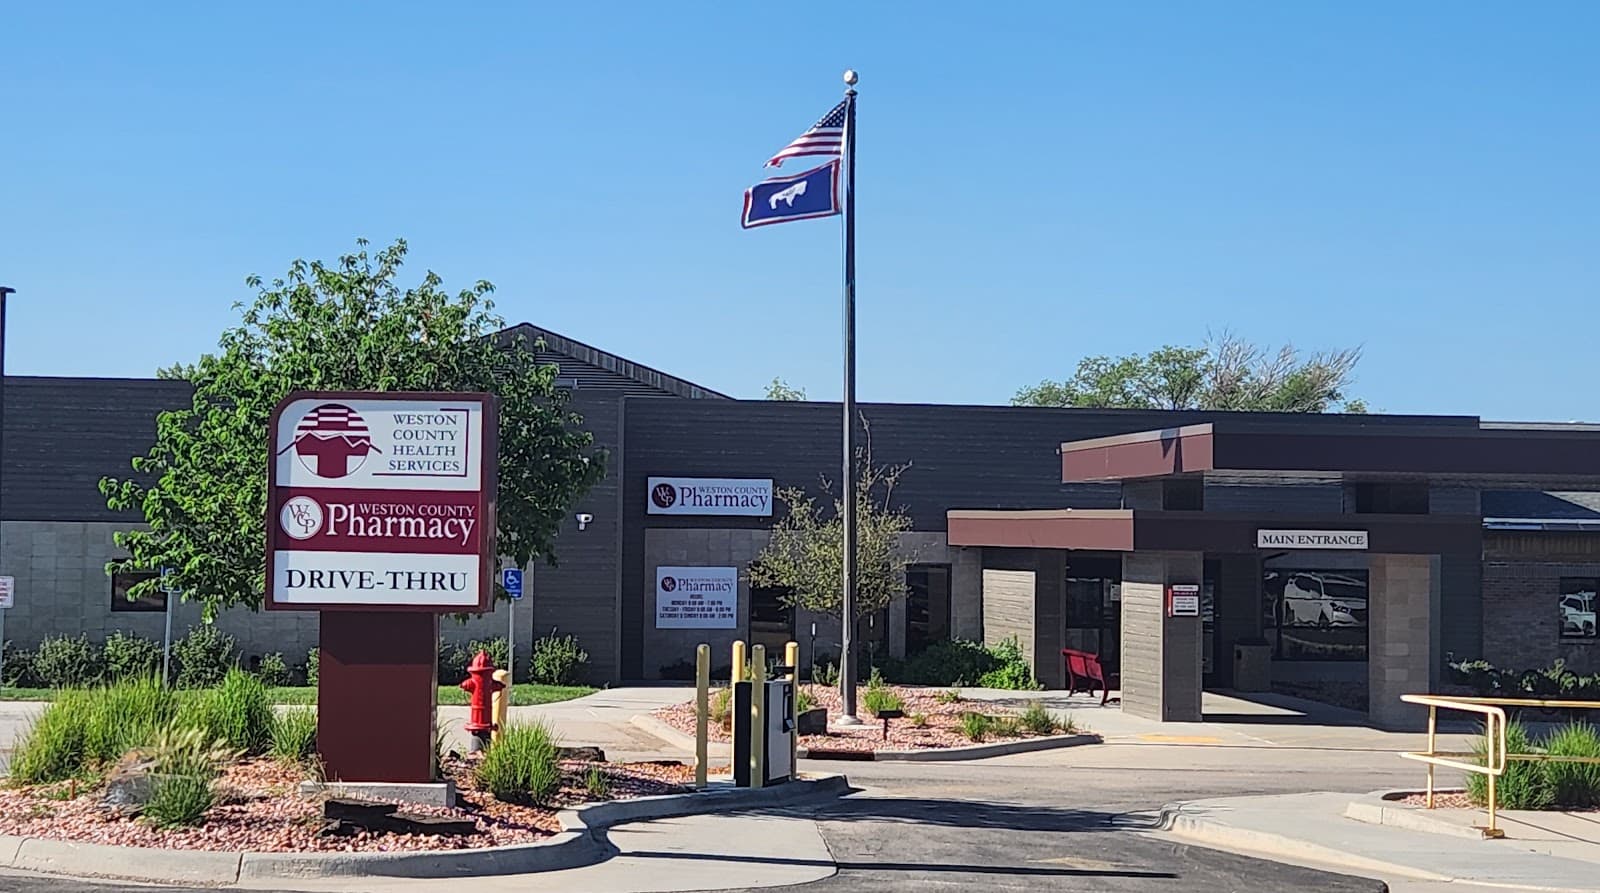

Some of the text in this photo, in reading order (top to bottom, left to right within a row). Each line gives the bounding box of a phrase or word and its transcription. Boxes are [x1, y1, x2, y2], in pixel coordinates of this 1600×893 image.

[393, 414, 457, 425] WESTON
[393, 430, 458, 441] COUNTY
[393, 446, 456, 457] HEALTH
[389, 460, 460, 472] SERVICES
[700, 486, 768, 495] WESTON COUNTY
[679, 486, 768, 512] Pharmacy
[359, 504, 475, 517] WESTON COUNTY
[326, 503, 475, 546] Pharmacy
[1262, 535, 1364, 545] MAIN ENTRANCE
[285, 569, 467, 591] DRIVE-THRU
[678, 578, 733, 594] Pharmacy
